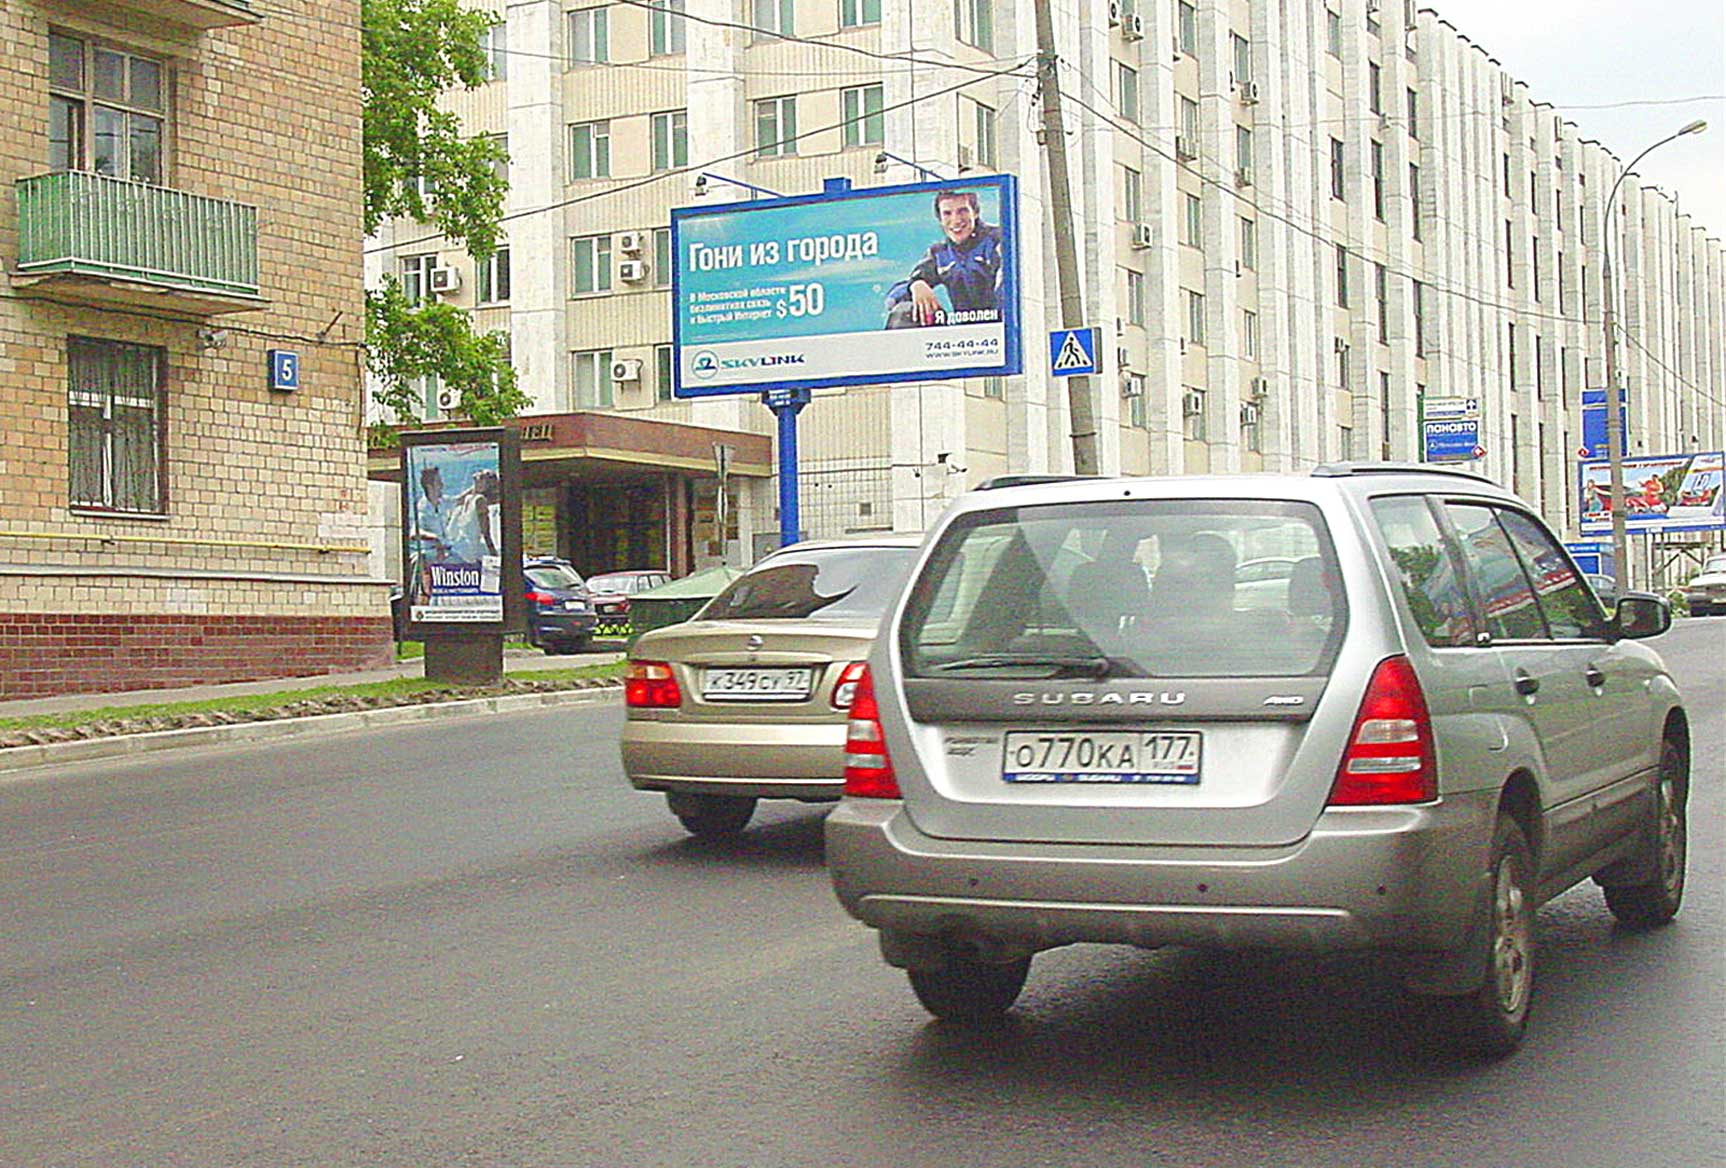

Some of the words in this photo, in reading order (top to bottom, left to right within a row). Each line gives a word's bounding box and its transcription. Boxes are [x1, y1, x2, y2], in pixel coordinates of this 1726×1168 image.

[688, 242, 743, 272] Гони
[750, 241, 780, 266] из
[787, 231, 878, 266] города
[935, 310, 945, 324] Я
[946, 309, 999, 325] доволен
[925, 339, 999, 351] 744-44-44
[282, 359, 292, 380] 5
[721, 354, 805, 368] SKYLINK
[431, 565, 480, 587] Winston
[1013, 692, 1186, 705] SUBARU
[1145, 736, 1192, 760] 177
